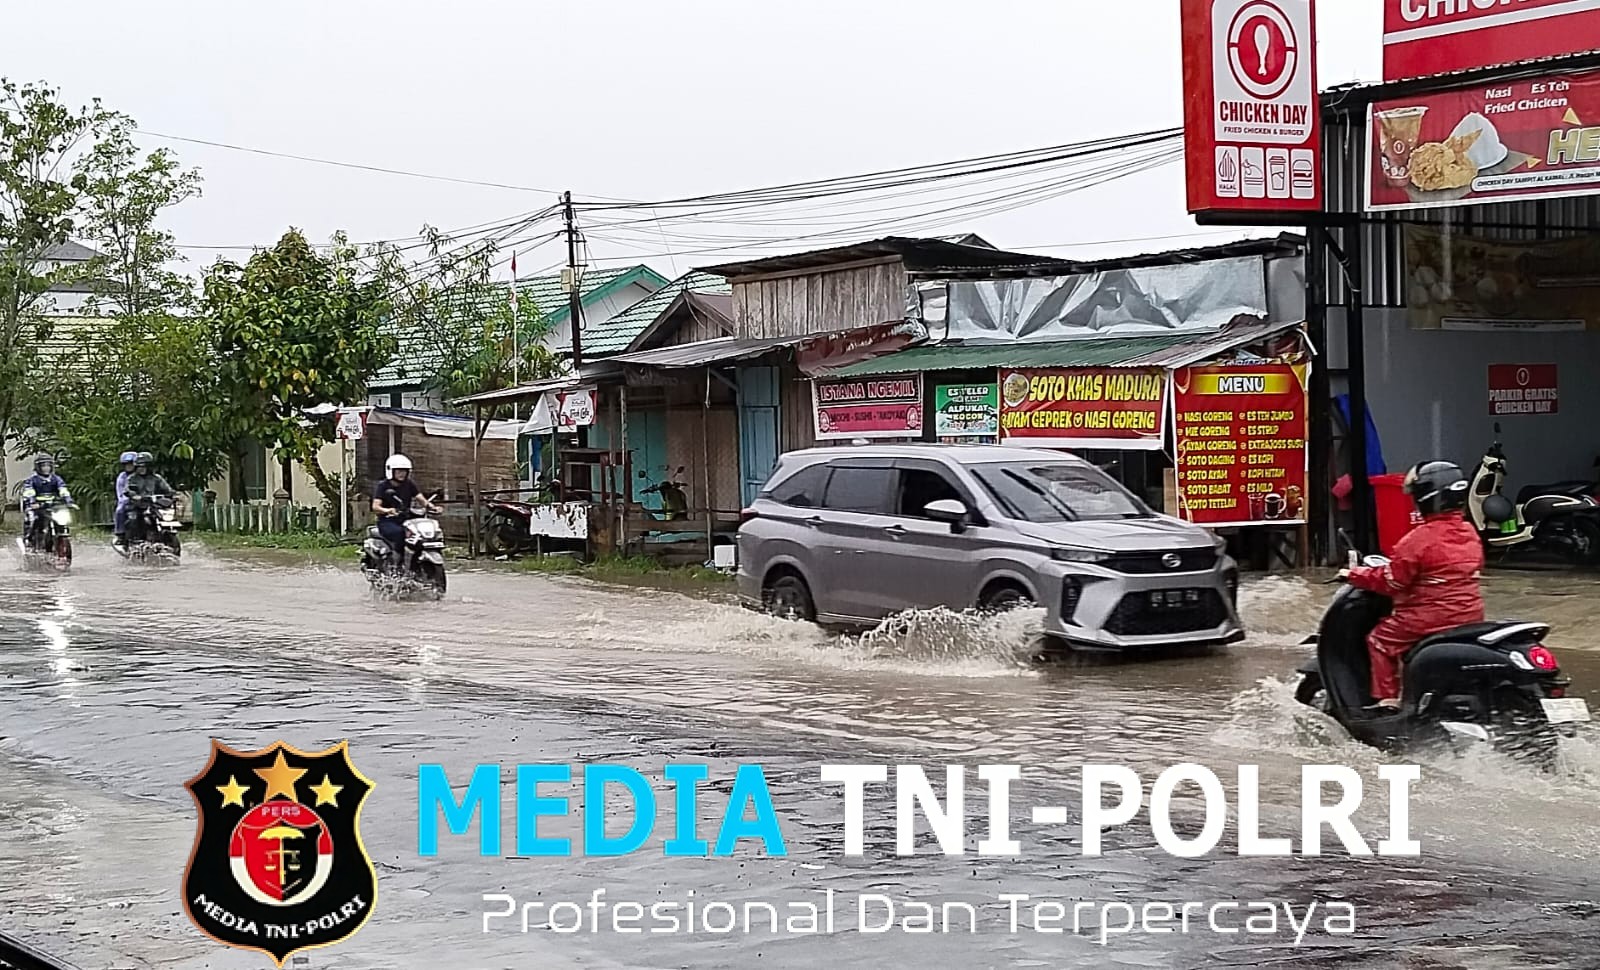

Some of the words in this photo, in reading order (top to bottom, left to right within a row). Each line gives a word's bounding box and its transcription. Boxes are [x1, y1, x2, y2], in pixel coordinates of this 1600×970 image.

[1485, 87, 1512, 99] Nasi
[1531, 83, 1546, 94] Es
[1548, 81, 1570, 91] Teh
[1484, 101, 1516, 114] Fried
[1517, 97, 1568, 111] Chicken
[1219, 100, 1280, 124] CHICKEN
[1282, 104, 1308, 125] DAY
[1223, 126, 1243, 134] FRIED
[1243, 127, 1272, 135] CHICKEN
[1029, 375, 1066, 401] SOTO
[1067, 375, 1103, 401] KHAS
[1104, 374, 1161, 401] MADURA
[1218, 376, 1265, 393] MENU
[820, 383, 865, 401] ISTANA
[867, 380, 915, 399] NGEMIL
[947, 388, 959, 396] ES
[1489, 389, 1523, 401] PARKIR
[1525, 388, 1557, 400] GRATIS
[948, 405, 989, 413] ALPUKAT
[1495, 402, 1534, 414] CHICKEN
[1535, 401, 1552, 412] DAY
[1031, 410, 1072, 428] GEPREK
[1084, 410, 1110, 428] NASI
[1112, 410, 1155, 428] GORENG
[1184, 412, 1202, 421] NASI
[1202, 412, 1233, 421] GORENG
[1247, 411, 1257, 421] ES
[1257, 411, 1270, 420] TEH
[1185, 427, 1199, 436] MIE
[1199, 426, 1230, 436] GORENG
[1247, 425, 1257, 436] ES
[1186, 441, 1207, 451] AYAM
[1207, 440, 1237, 450] GORENG
[1248, 439, 1286, 449] EXTRAJOSS
[1186, 455, 1207, 465] SOTO
[1208, 454, 1235, 464] DAGING
[1248, 454, 1258, 464] ES
[1258, 454, 1274, 464] KOPI
[1186, 470, 1207, 480] SOTO
[1208, 469, 1228, 479] AYAM
[1247, 469, 1265, 478] KOPI
[1265, 468, 1285, 477] HITAM
[1187, 484, 1207, 494] SOTO
[1208, 483, 1231, 494] BABAT
[1247, 483, 1256, 492] ES
[1256, 483, 1273, 492] MILO
[1187, 499, 1208, 509] SOTO
[1208, 498, 1237, 508] TETELAN
